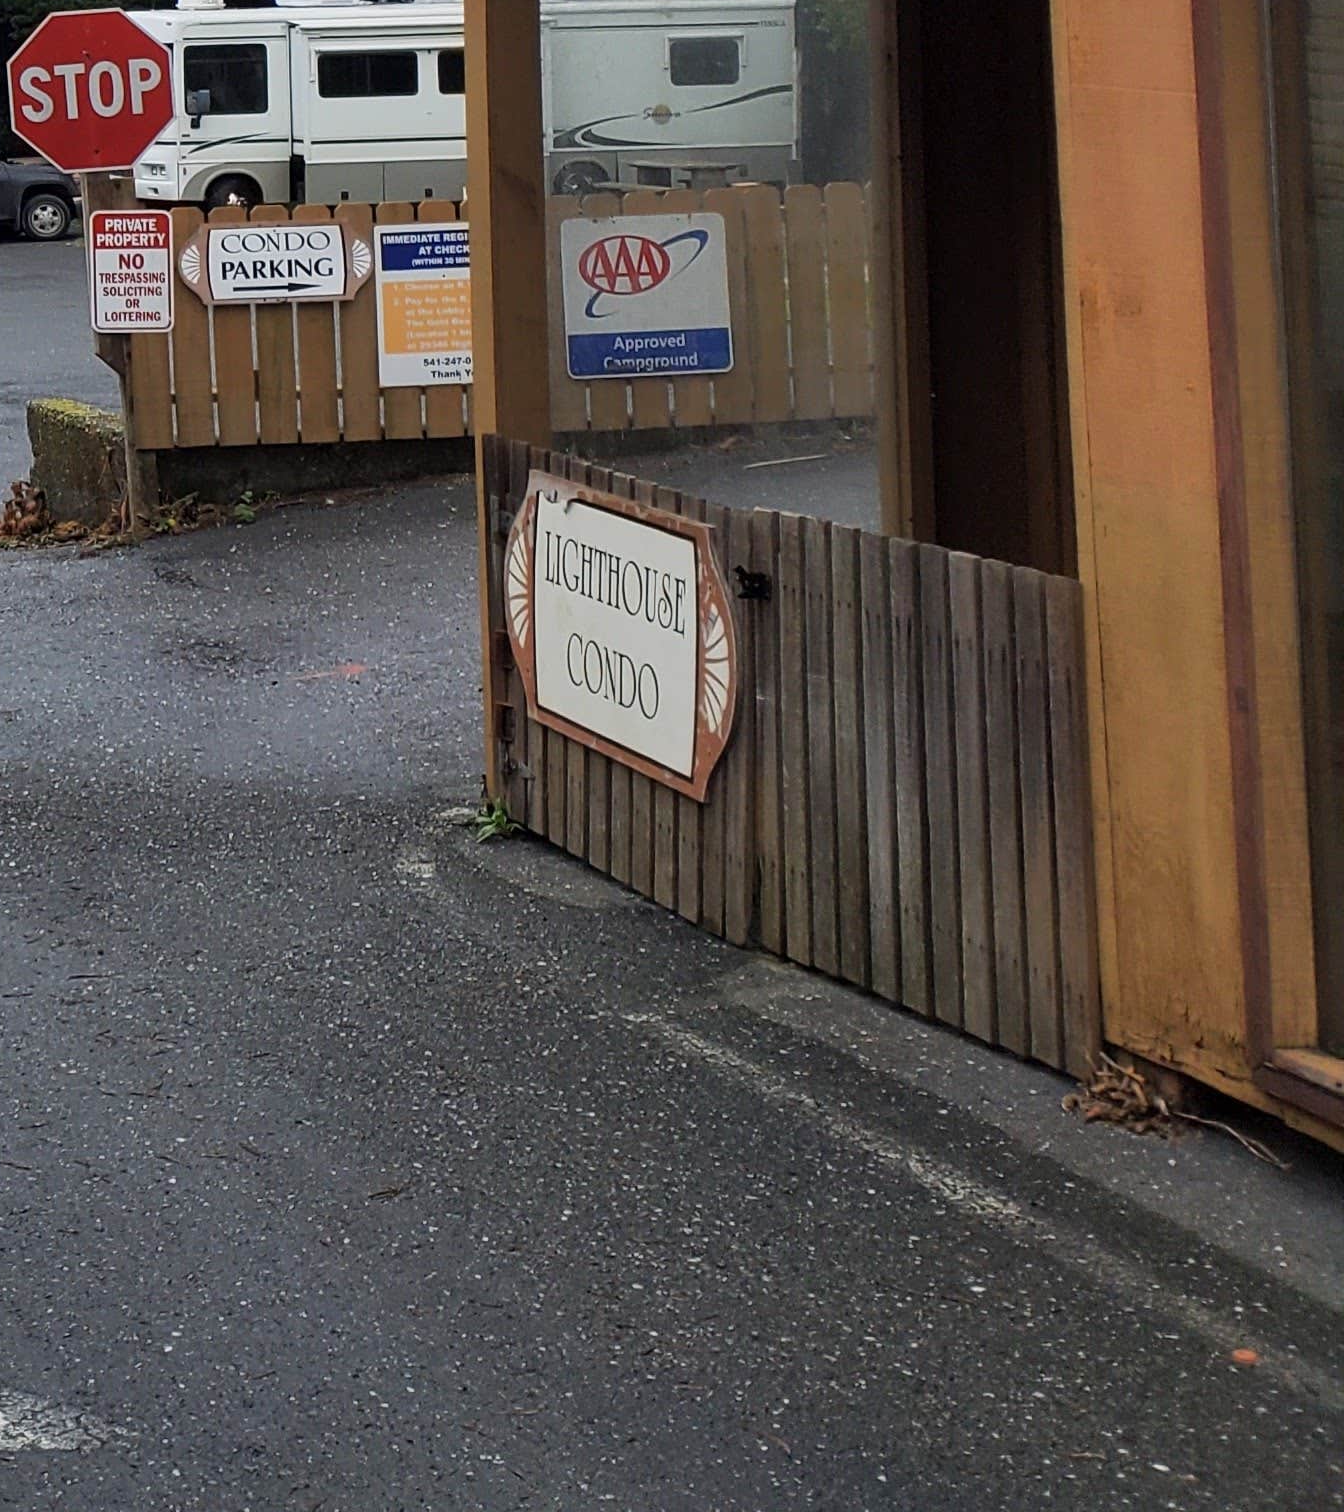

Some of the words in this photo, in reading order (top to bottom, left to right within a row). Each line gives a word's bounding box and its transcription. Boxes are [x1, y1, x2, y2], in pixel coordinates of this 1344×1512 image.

[20, 58, 161, 123] STOP
[105, 219, 157, 232] PRIVATE
[96, 233, 166, 247] PROPERTY
[221, 231, 330, 254] CONDO
[382, 234, 440, 245] IMMEDIATE
[418, 246, 432, 256] AT
[434, 244, 470, 255] CHECK
[118, 253, 144, 270] NO
[412, 257, 443, 267] (WITHIN
[444, 257, 454, 265] 30
[586, 235, 665, 295] AAA
[221, 257, 333, 280] PARKING
[99, 272, 166, 284] TRESPASSING
[103, 286, 163, 297] SOLICITING
[125, 299, 140, 309] OR
[105, 311, 161, 322] LOITERING
[613, 333, 686, 352] Approved
[431, 370, 461, 378] Thank
[545, 531, 687, 637] LIGHTHOUSE
[567, 633, 659, 719] CONDO
